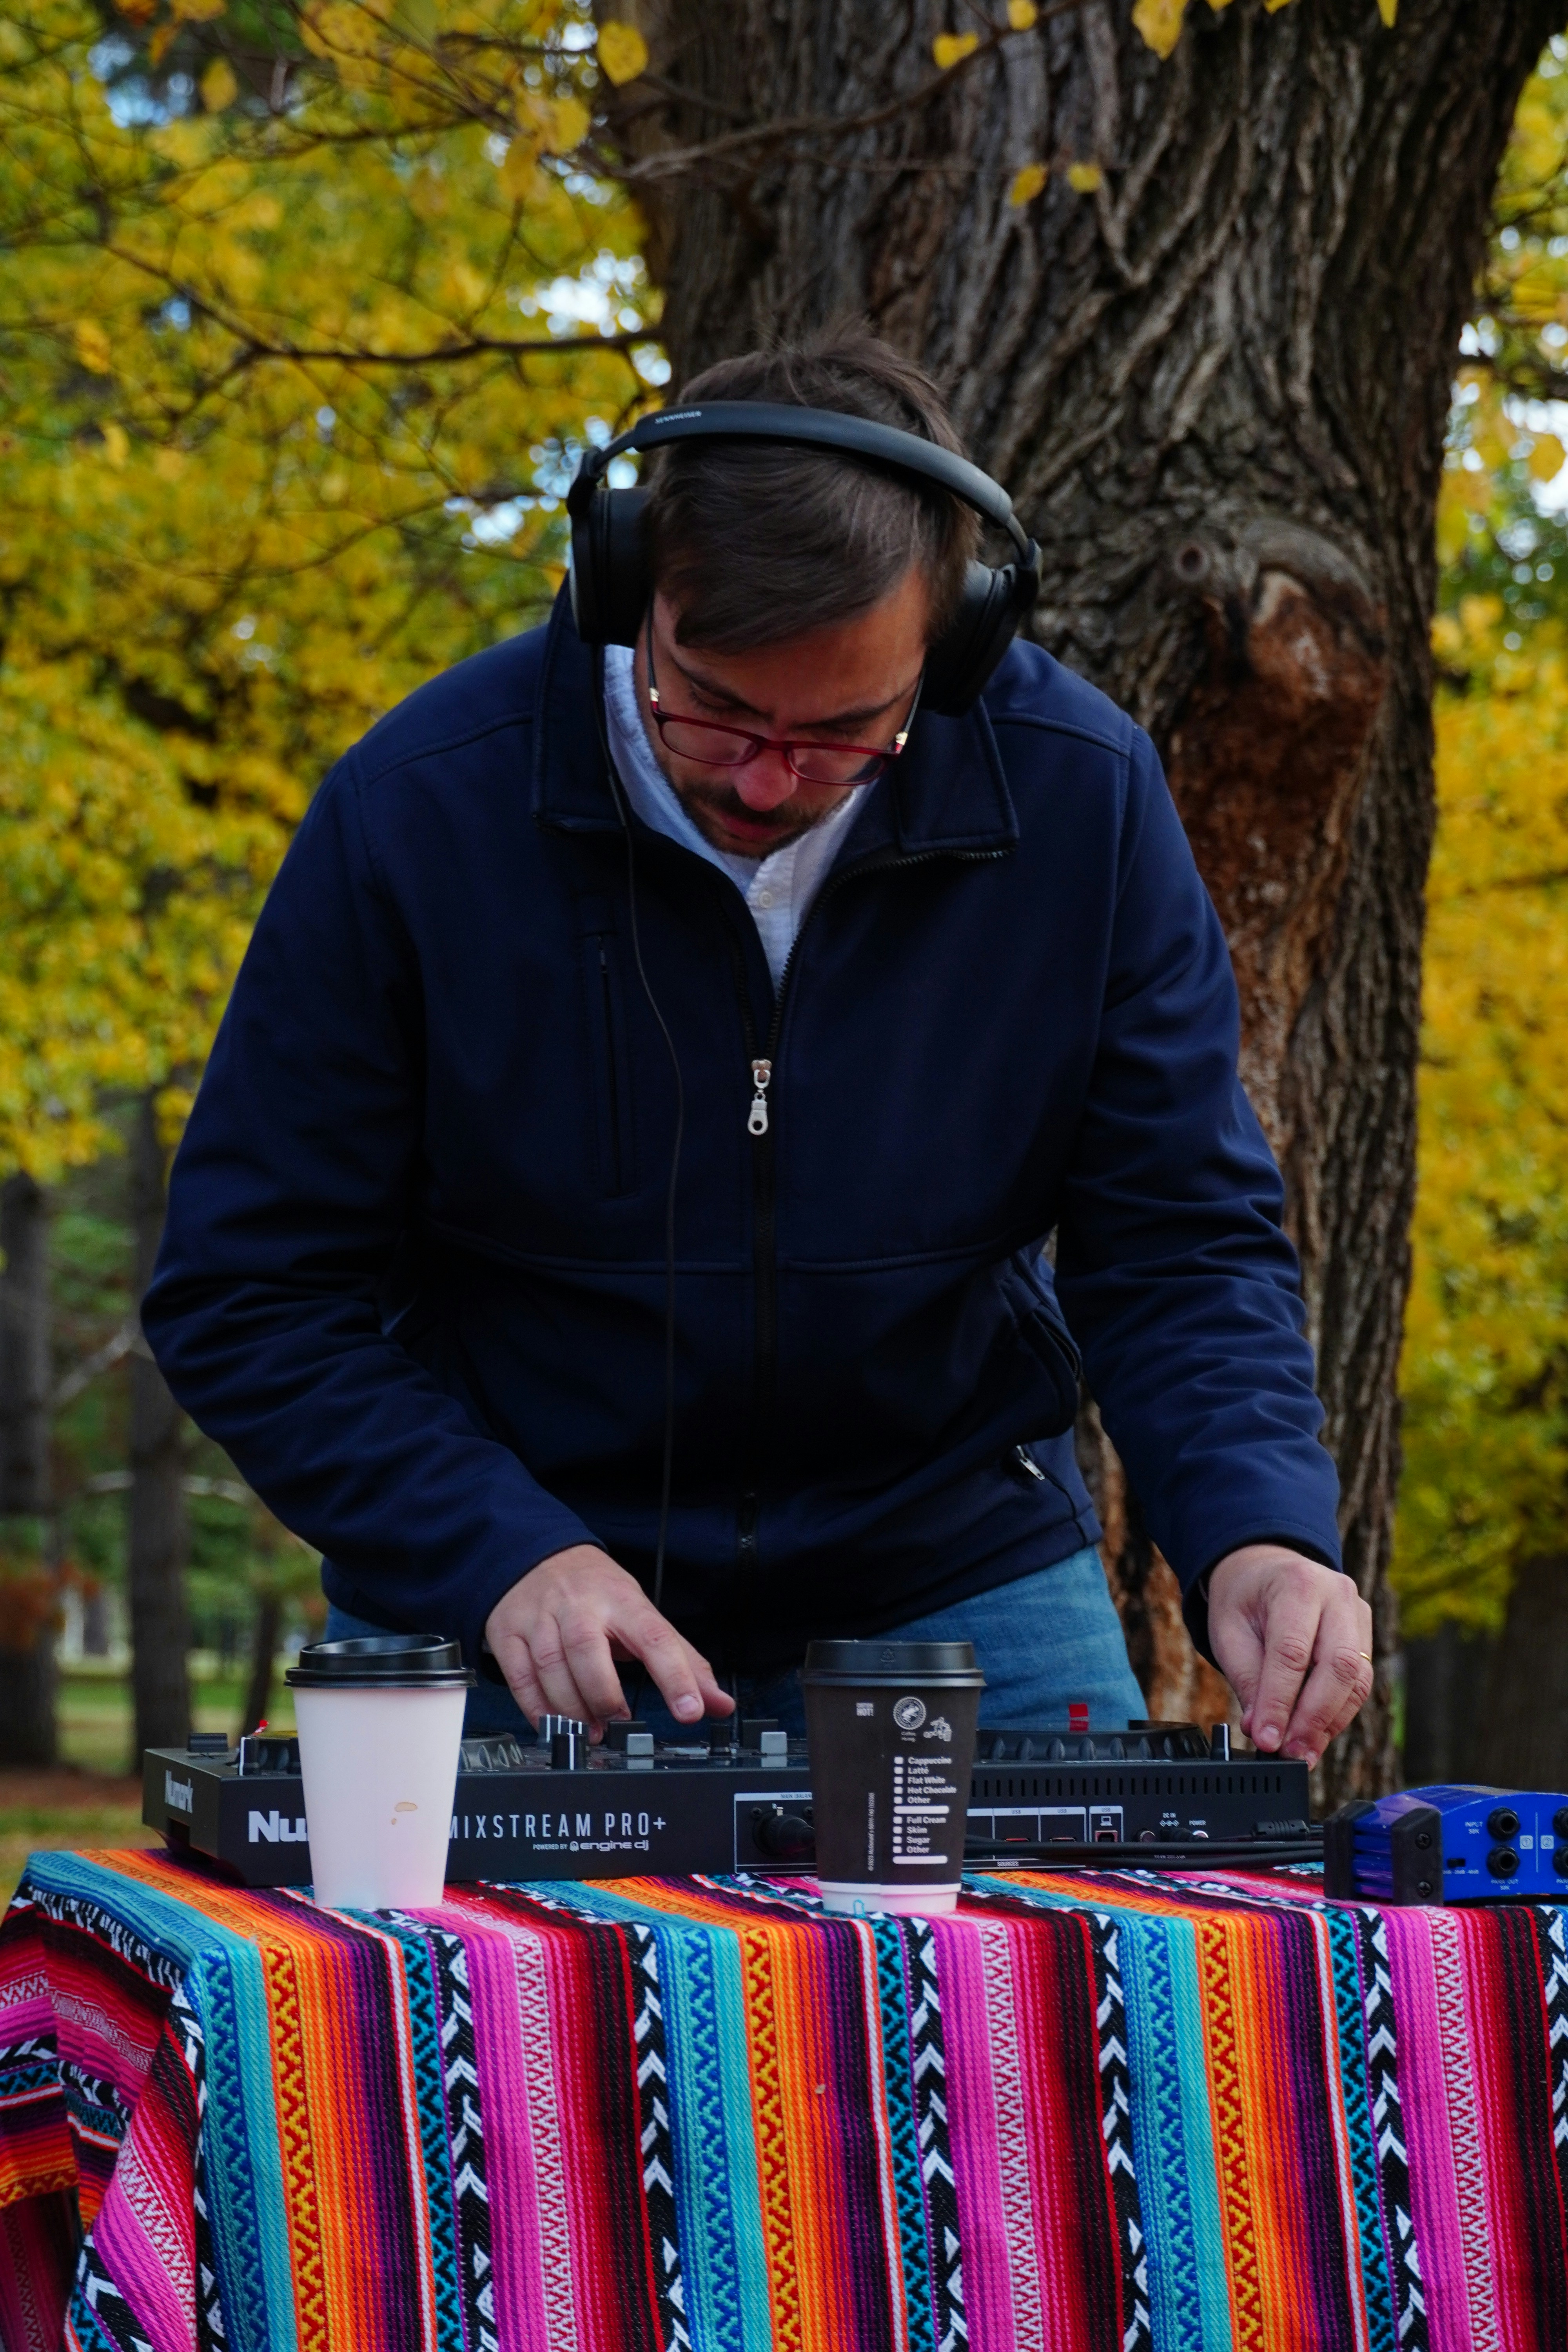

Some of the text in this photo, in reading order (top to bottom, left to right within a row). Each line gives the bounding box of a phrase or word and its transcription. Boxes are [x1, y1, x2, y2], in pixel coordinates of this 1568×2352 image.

[908, 1757, 952, 1766] Cappuccino
[165, 1769, 193, 1813] Numark
[605, 1812, 666, 1836] PRO+
[580, 1840, 632, 1851] engine
[634, 1840, 649, 1851] dj
[906, 1836, 931, 1845] Sugar
